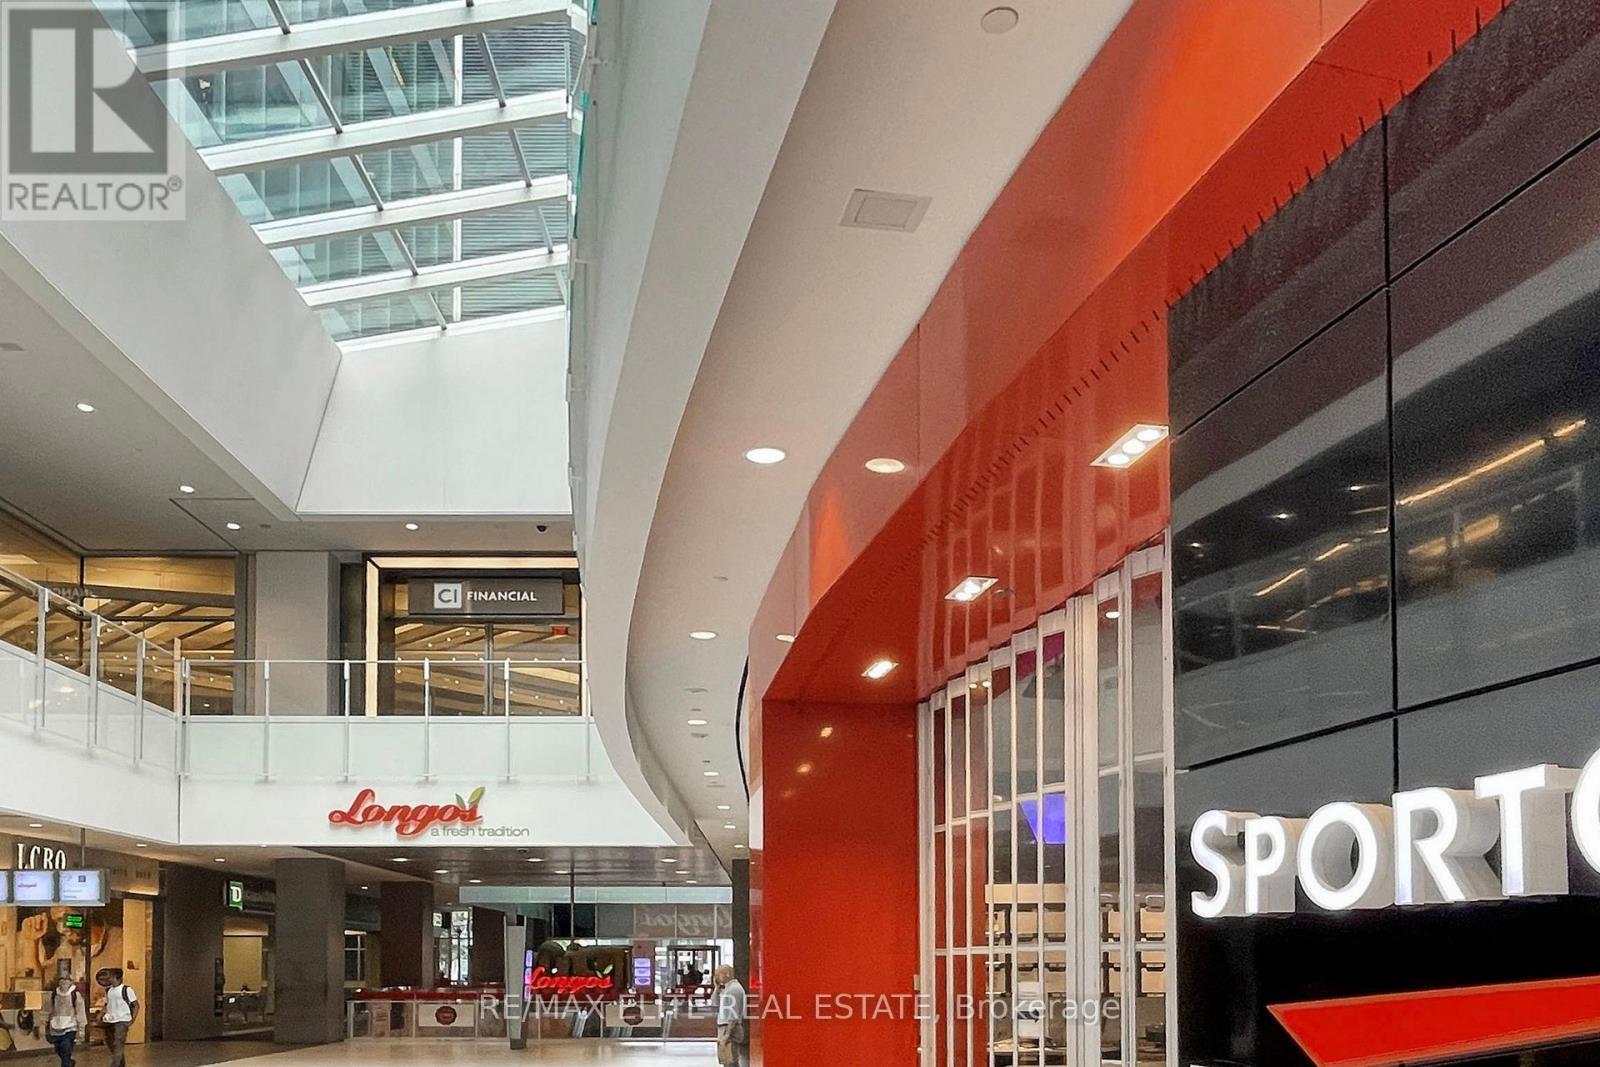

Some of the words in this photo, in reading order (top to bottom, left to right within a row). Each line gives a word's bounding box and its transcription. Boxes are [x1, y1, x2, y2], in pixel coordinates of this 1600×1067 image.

[438, 588, 457, 603] CI
[466, 591, 537, 602] FINANCIAL
[430, 826, 440, 836] a
[442, 825, 475, 837] fresh
[477, 825, 530, 837] tradition
